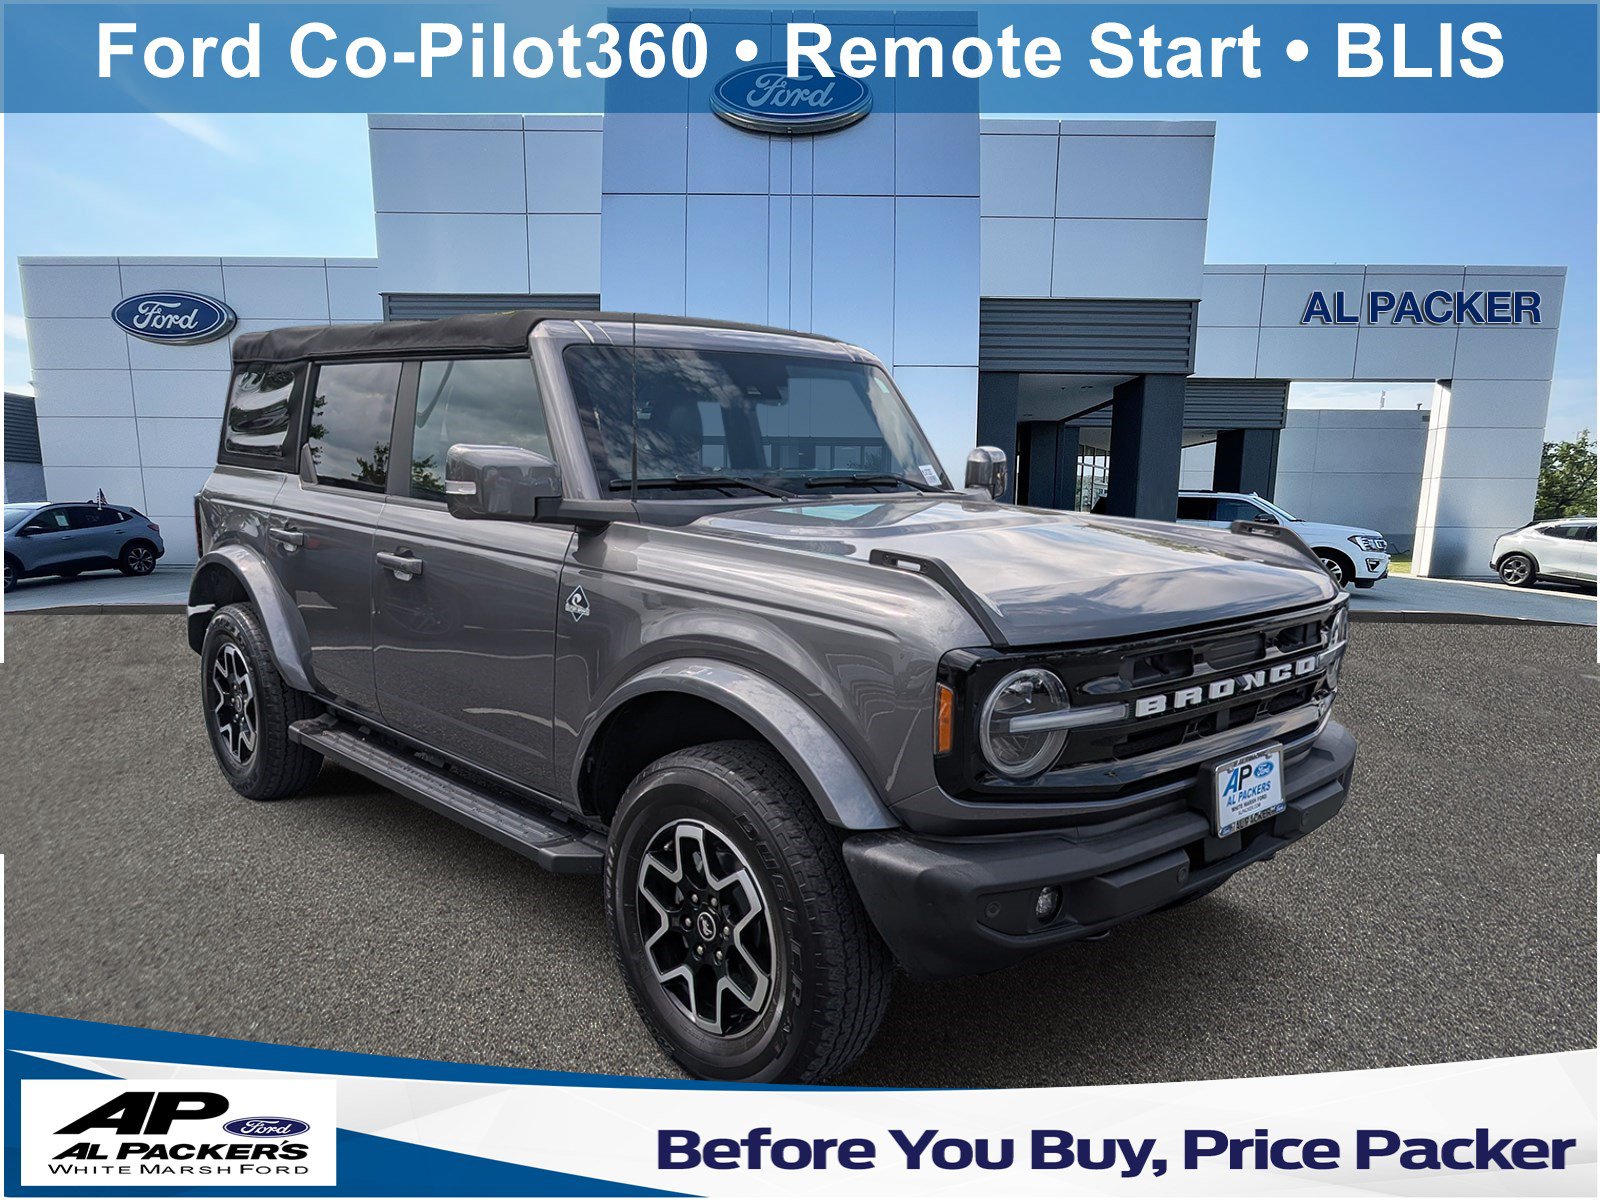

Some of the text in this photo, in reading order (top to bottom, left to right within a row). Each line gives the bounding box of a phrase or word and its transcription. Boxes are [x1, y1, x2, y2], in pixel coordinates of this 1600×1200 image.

[746, 73, 836, 108] Ford
[133, 301, 199, 329] Ford
[1301, 289, 1542, 324] AL PACKER
[1135, 655, 1315, 717] BRONCO
[1222, 764, 1252, 797] AP
[1227, 792, 1237, 807] AL
